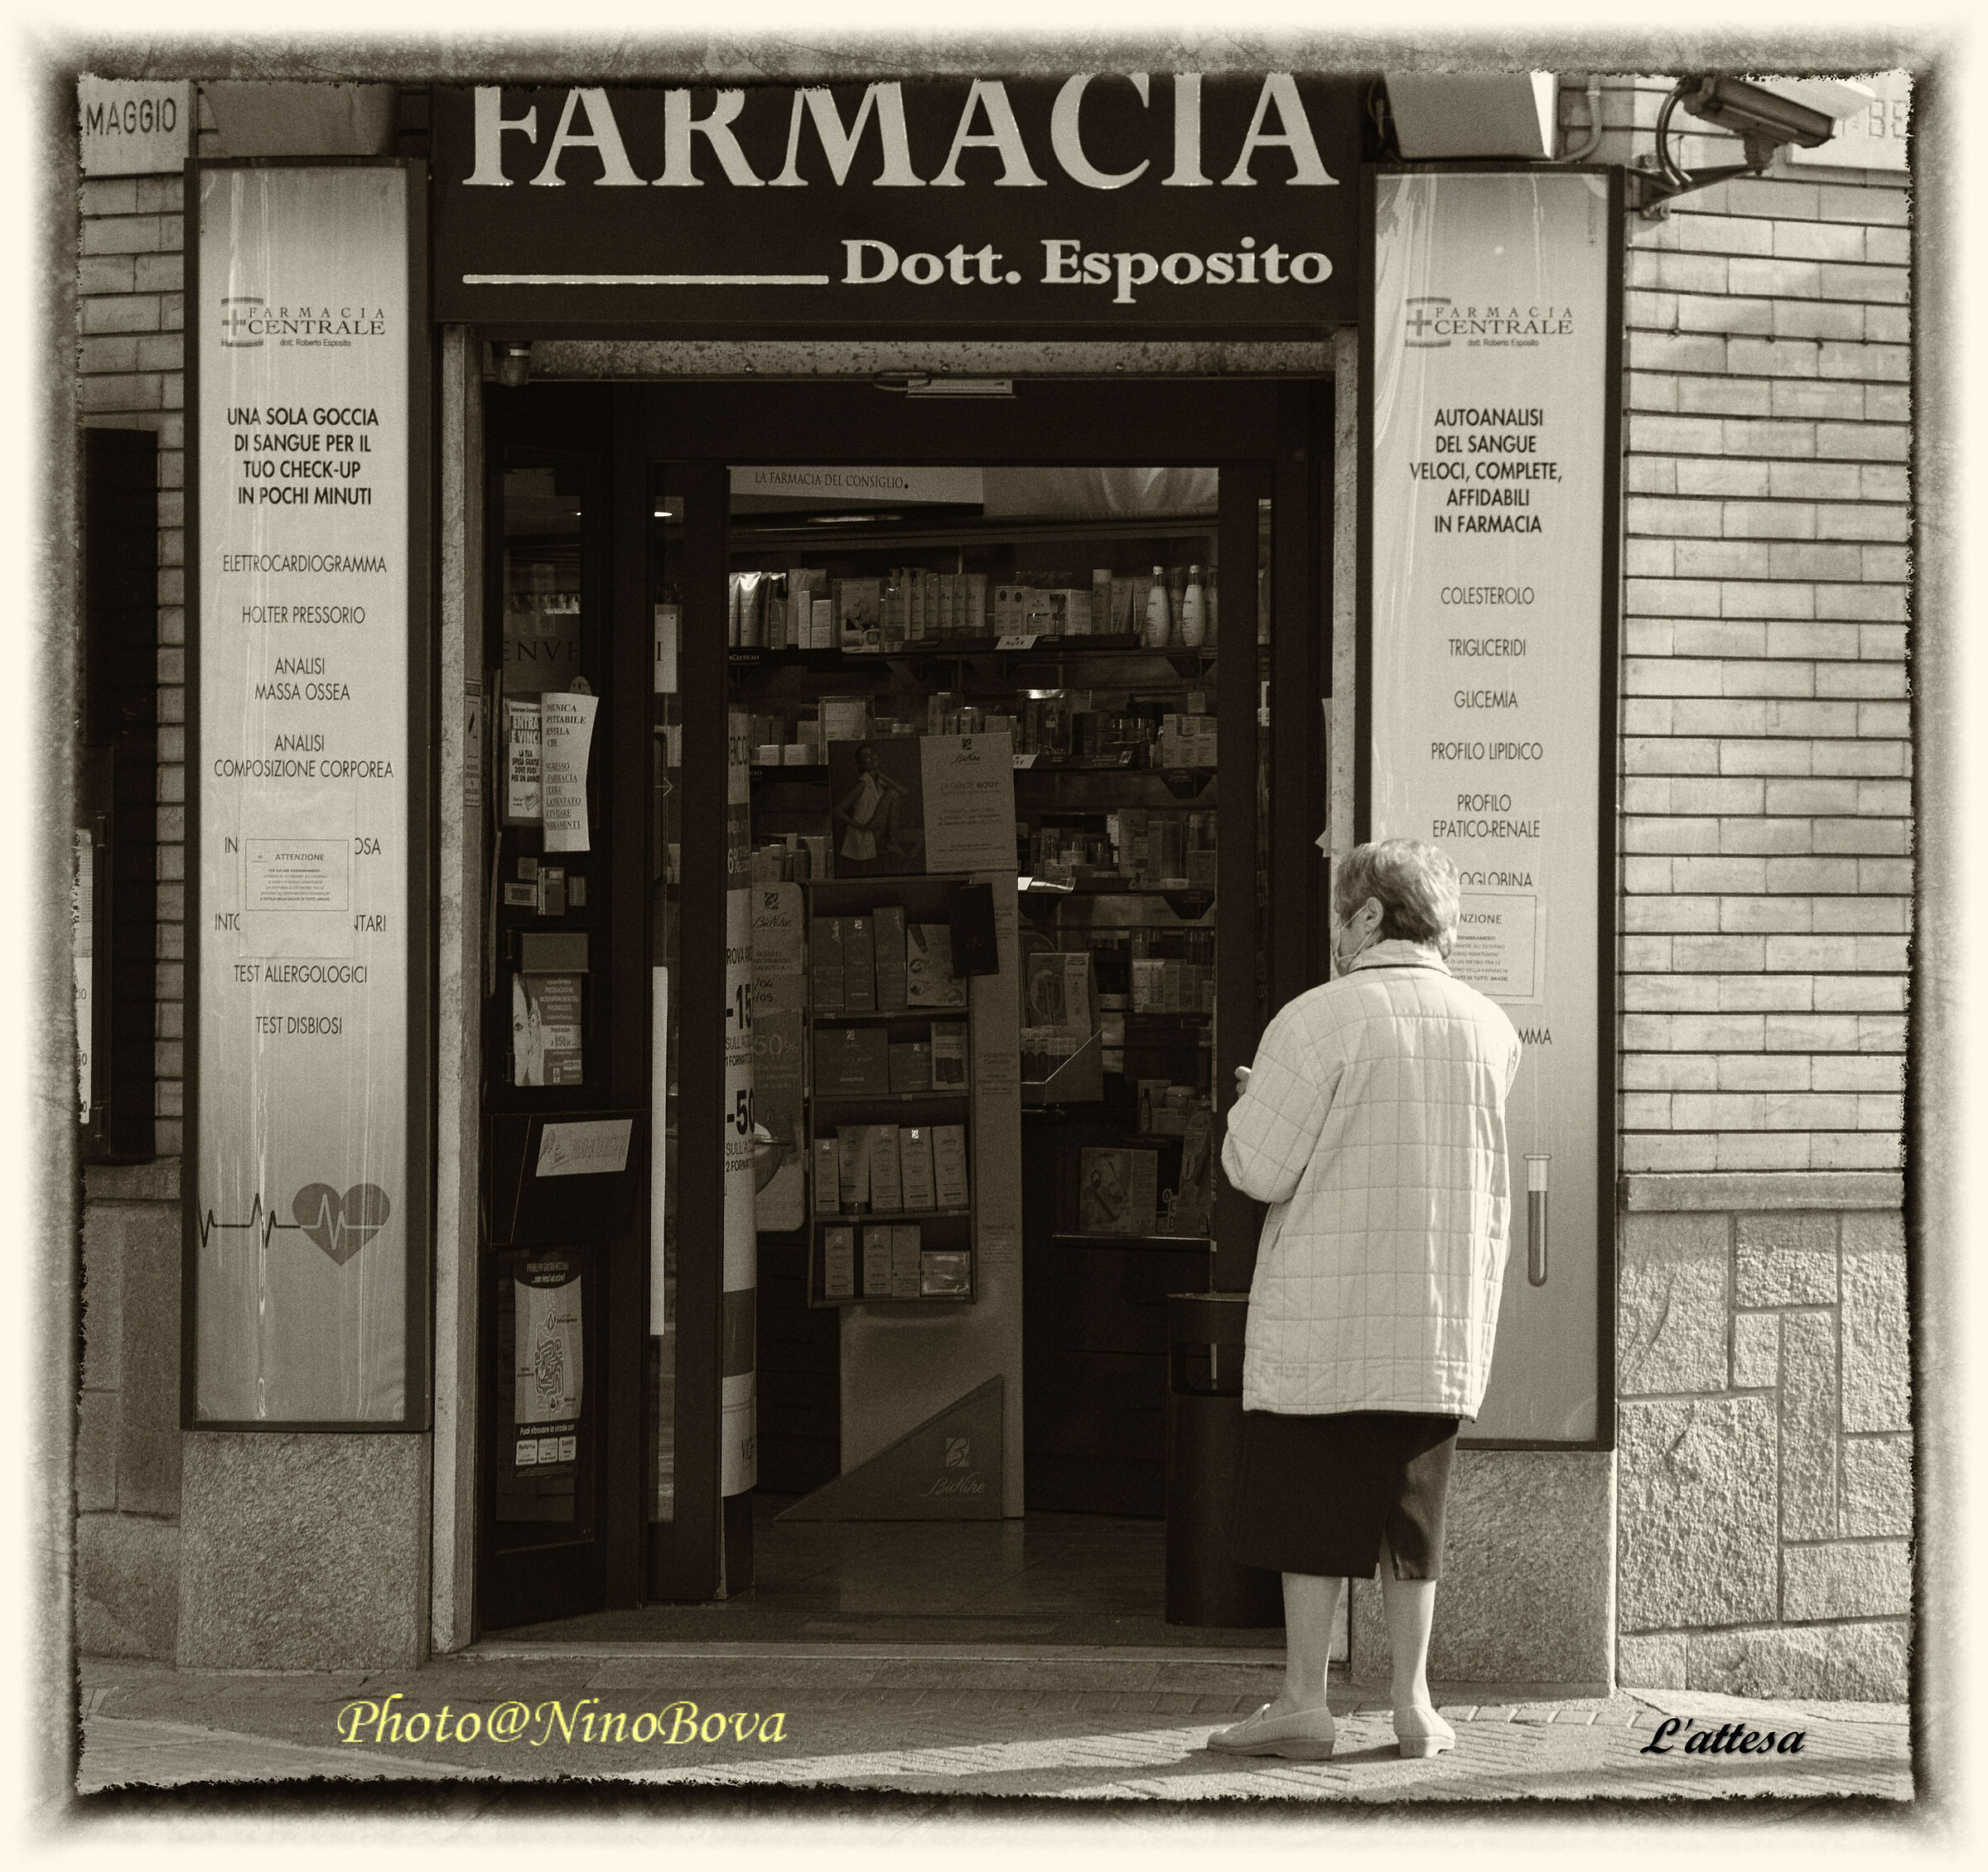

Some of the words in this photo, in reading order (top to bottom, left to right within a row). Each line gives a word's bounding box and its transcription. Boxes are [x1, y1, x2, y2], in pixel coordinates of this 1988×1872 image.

[86, 98, 176, 136] MAGGIO
[462, 72, 1339, 189] FARMACIA
[840, 239, 1021, 286] Dott.
[1040, 237, 1334, 304] Esposito
[248, 307, 385, 319] FARMACIA
[1436, 307, 1573, 319] FARMACIA
[248, 320, 386, 335] CENTRALE
[1434, 320, 1573, 335] CENTRALE
[227, 408, 262, 426] UNA
[266, 408, 308, 427] SOLA
[313, 408, 379, 427] GOCCIA
[1434, 408, 1544, 427] AUTOANALISI
[234, 433, 248, 452] DI
[253, 434, 321, 453] SANGUE
[326, 434, 355, 452] PER
[359, 434, 371, 452] IL
[1436, 435, 1463, 453] DEL
[1468, 435, 1537, 453] SANGUE
[243, 461, 274, 479] TUO
[279, 461, 361, 479] CHECK-UP
[770, 472, 822, 485] FARMACIA
[824, 473, 843, 486] DEL
[1409, 462, 1470, 482] VELOCI,
[1474, 462, 1562, 482] COMPLETE,
[238, 487, 253, 505] IN
[258, 487, 308, 505] POCHI
[314, 487, 371, 505] MINUTI
[1446, 488, 1529, 507] AFFIDABILI
[1435, 514, 1452, 533] IN
[1456, 514, 1542, 533] FARMACIA
[223, 554, 387, 572] ELETTROCARDIOGRAMMA
[1440, 586, 1535, 605] COLESTEROLO
[242, 606, 288, 623] HOLTER
[292, 606, 365, 624] PRESSORIO
[1449, 639, 1526, 657] TRIGLICERIDI
[274, 658, 326, 674] ANALISI
[254, 683, 301, 700] MASSA
[305, 683, 350, 700] OSSEA
[1454, 690, 1518, 708] GLICEMIA
[274, 734, 325, 751] ANALISI
[1431, 742, 1484, 760] PROFILO
[1489, 742, 1543, 760] LIPIDICO
[214, 760, 316, 777] COMPOSIZIONE
[320, 760, 394, 778] CORPOREA
[1457, 794, 1511, 812] PROFILO
[1432, 820, 1540, 837] EPATICO-RENALE
[224, 837, 239, 854] IN
[274, 853, 325, 861] ATTENZIONE
[234, 965, 260, 982] TEST
[264, 965, 368, 983] ALLERGOLOGICI
[255, 1016, 283, 1034] TEST
[287, 1016, 343, 1035] DISBIOSI
